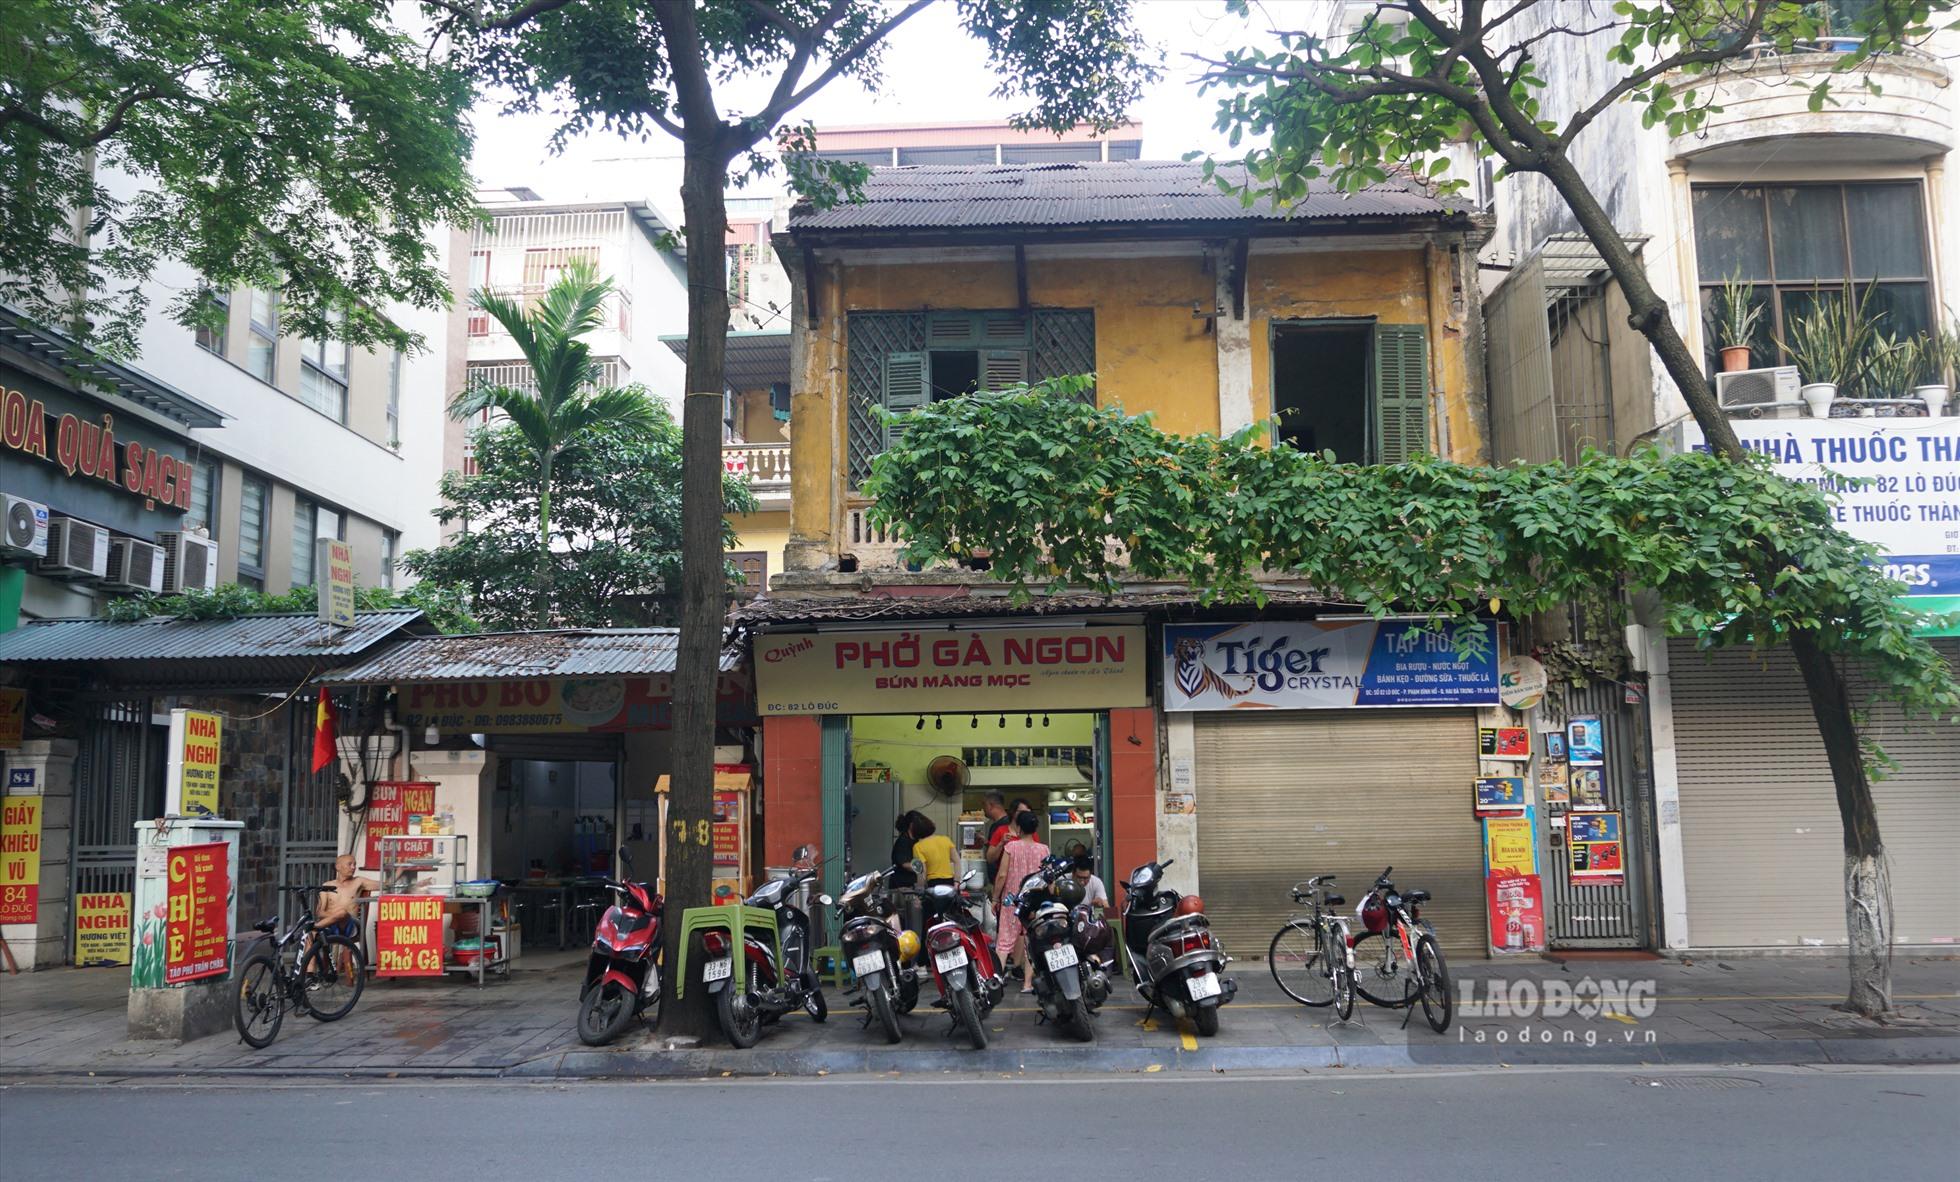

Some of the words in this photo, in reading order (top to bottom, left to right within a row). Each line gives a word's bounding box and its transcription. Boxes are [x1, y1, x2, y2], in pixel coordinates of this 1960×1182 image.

[0, 385, 47, 458] OA
[57, 413, 116, 484] QUẢ
[126, 441, 193, 512] SẠCH
[1812, 427, 1907, 463] THUỐC
[1877, 476, 1898, 493] 82
[1905, 471, 1926, 493] LÒ
[1853, 498, 1911, 522] THUỐC
[764, 638, 814, 663] Quỳnh
[835, 633, 921, 669] PHỞ
[932, 632, 992, 667] GÀ
[1003, 636, 1125, 666] NGON
[1385, 633, 1419, 657] TẠP
[1215, 635, 1331, 692] Tiger
[1452, 661, 1470, 672] NGỌT
[875, 674, 918, 689] BÚN
[987, 674, 1031, 689] MỌC
[1287, 674, 1363, 689] CRYSTAL
[1376, 673, 1395, 683] BÁNH
[1396, 674, 1409, 684] KẸO
[1439, 672, 1454, 682] SỮA
[1458, 671, 1481, 682] THUỐC
[1481, 672, 1490, 682] LÁ
[1501, 671, 1521, 687] 4G
[801, 701, 815, 711] LÒ
[817, 700, 839, 710] ĐÚC
[189, 717, 217, 738] NHÀ
[186, 741, 218, 765] NGHỈ
[12, 772, 31, 783] 84
[373, 782, 397, 801] BÚN
[404, 790, 433, 812] NGAN
[4, 801, 36, 826] GIẤY
[369, 803, 400, 822] MIẾN
[0, 831, 38, 853] KHIÊU
[8, 858, 26, 880] VŨ
[4, 886, 28, 902] 84
[81, 892, 125, 909] NHÀ
[11, 902, 33, 913] ĐÚC
[380, 898, 406, 921] BÚN
[409, 897, 441, 921] MIẾN
[78, 909, 129, 929] NGHỈ
[80, 932, 108, 941] HƯƠNG
[110, 932, 126, 941] VIỆT
[393, 925, 428, 945] NGAN
[379, 947, 413, 971] Phở
[417, 948, 440, 970] Gà
